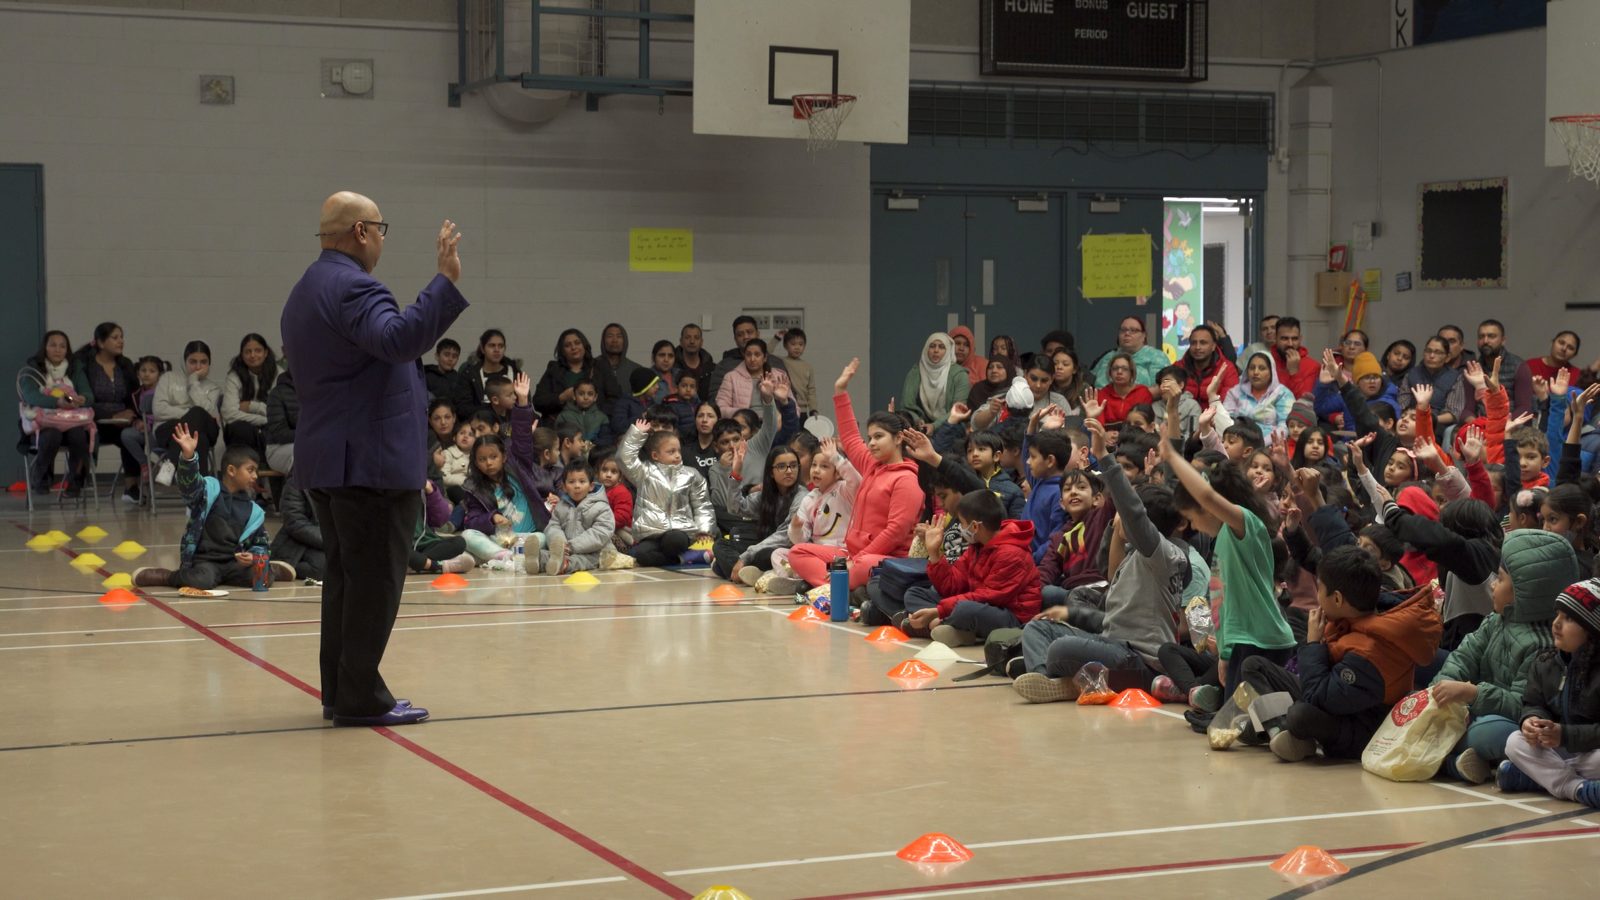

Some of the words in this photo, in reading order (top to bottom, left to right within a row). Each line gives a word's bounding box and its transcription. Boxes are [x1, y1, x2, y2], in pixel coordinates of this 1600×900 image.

[1004, 0, 1054, 14] HOME
[1075, 0, 1109, 10] BONUS
[1126, 2, 1178, 20] GUEST
[1075, 28, 1109, 40] PERIOD
